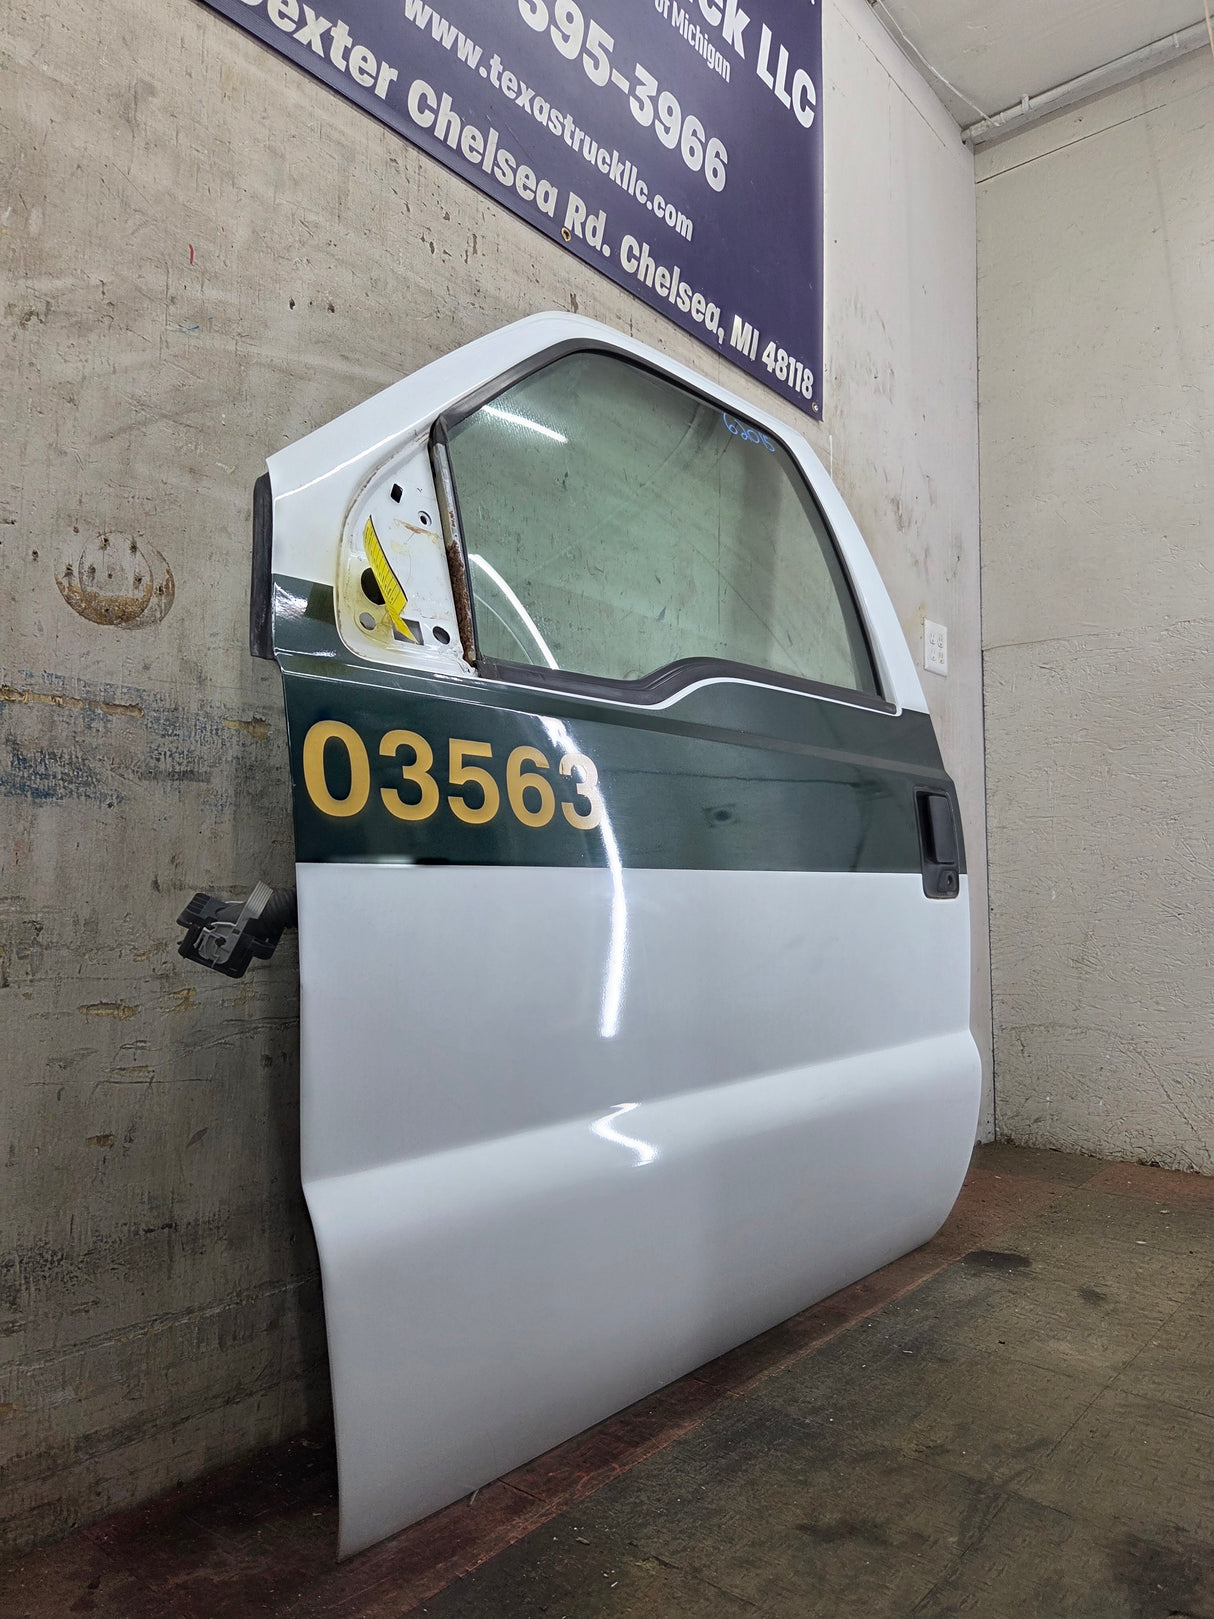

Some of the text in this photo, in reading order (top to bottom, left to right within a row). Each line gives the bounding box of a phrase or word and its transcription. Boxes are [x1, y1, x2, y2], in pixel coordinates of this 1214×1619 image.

[671, 0, 731, 84] Michigan
[756, 23, 816, 129] LLC
[404, 0, 694, 242] www.texastruckllc.com
[240, 0, 814, 399] exter Chelsea Rd. Chelsea, MI 48118
[303, 719, 601, 830] 03563
